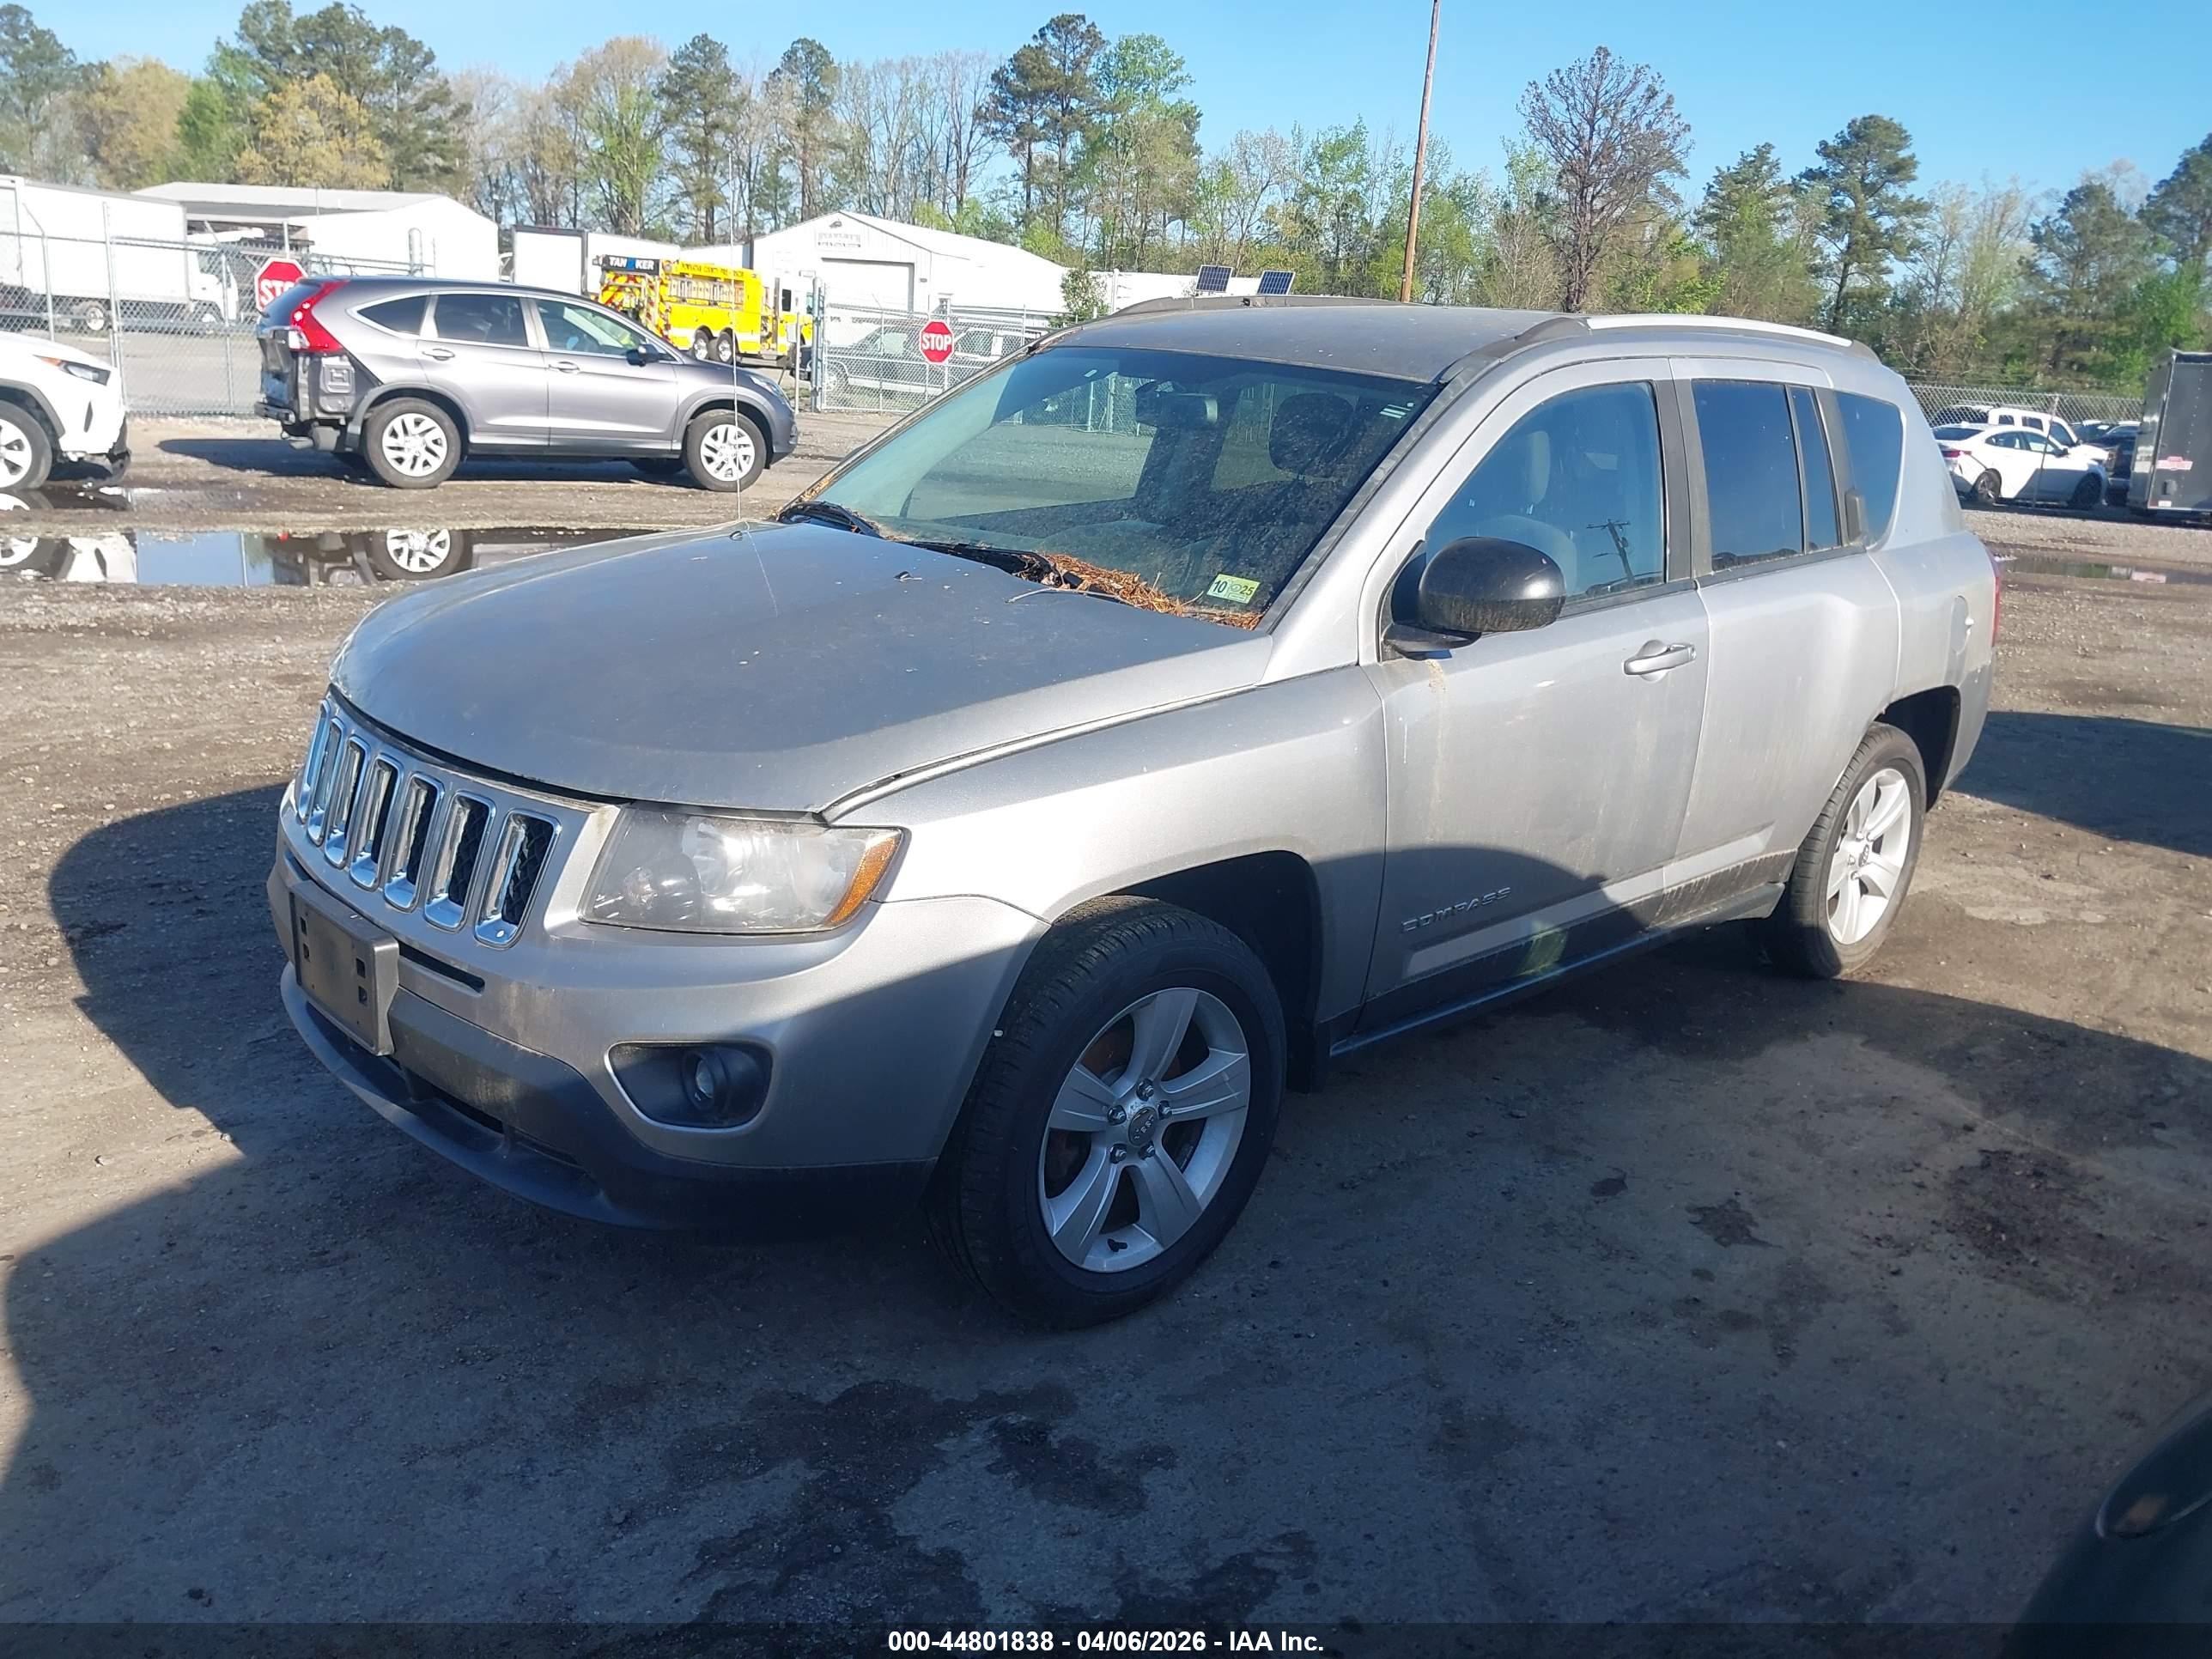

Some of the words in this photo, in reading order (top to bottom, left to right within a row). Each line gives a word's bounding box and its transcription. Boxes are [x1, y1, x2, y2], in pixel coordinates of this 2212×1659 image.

[260, 279, 301, 306] ST
[921, 332, 952, 351] STOP
[1212, 580, 1227, 593] 10
[1240, 585, 1255, 596] 25
[1401, 887, 1510, 932] COMPASS
